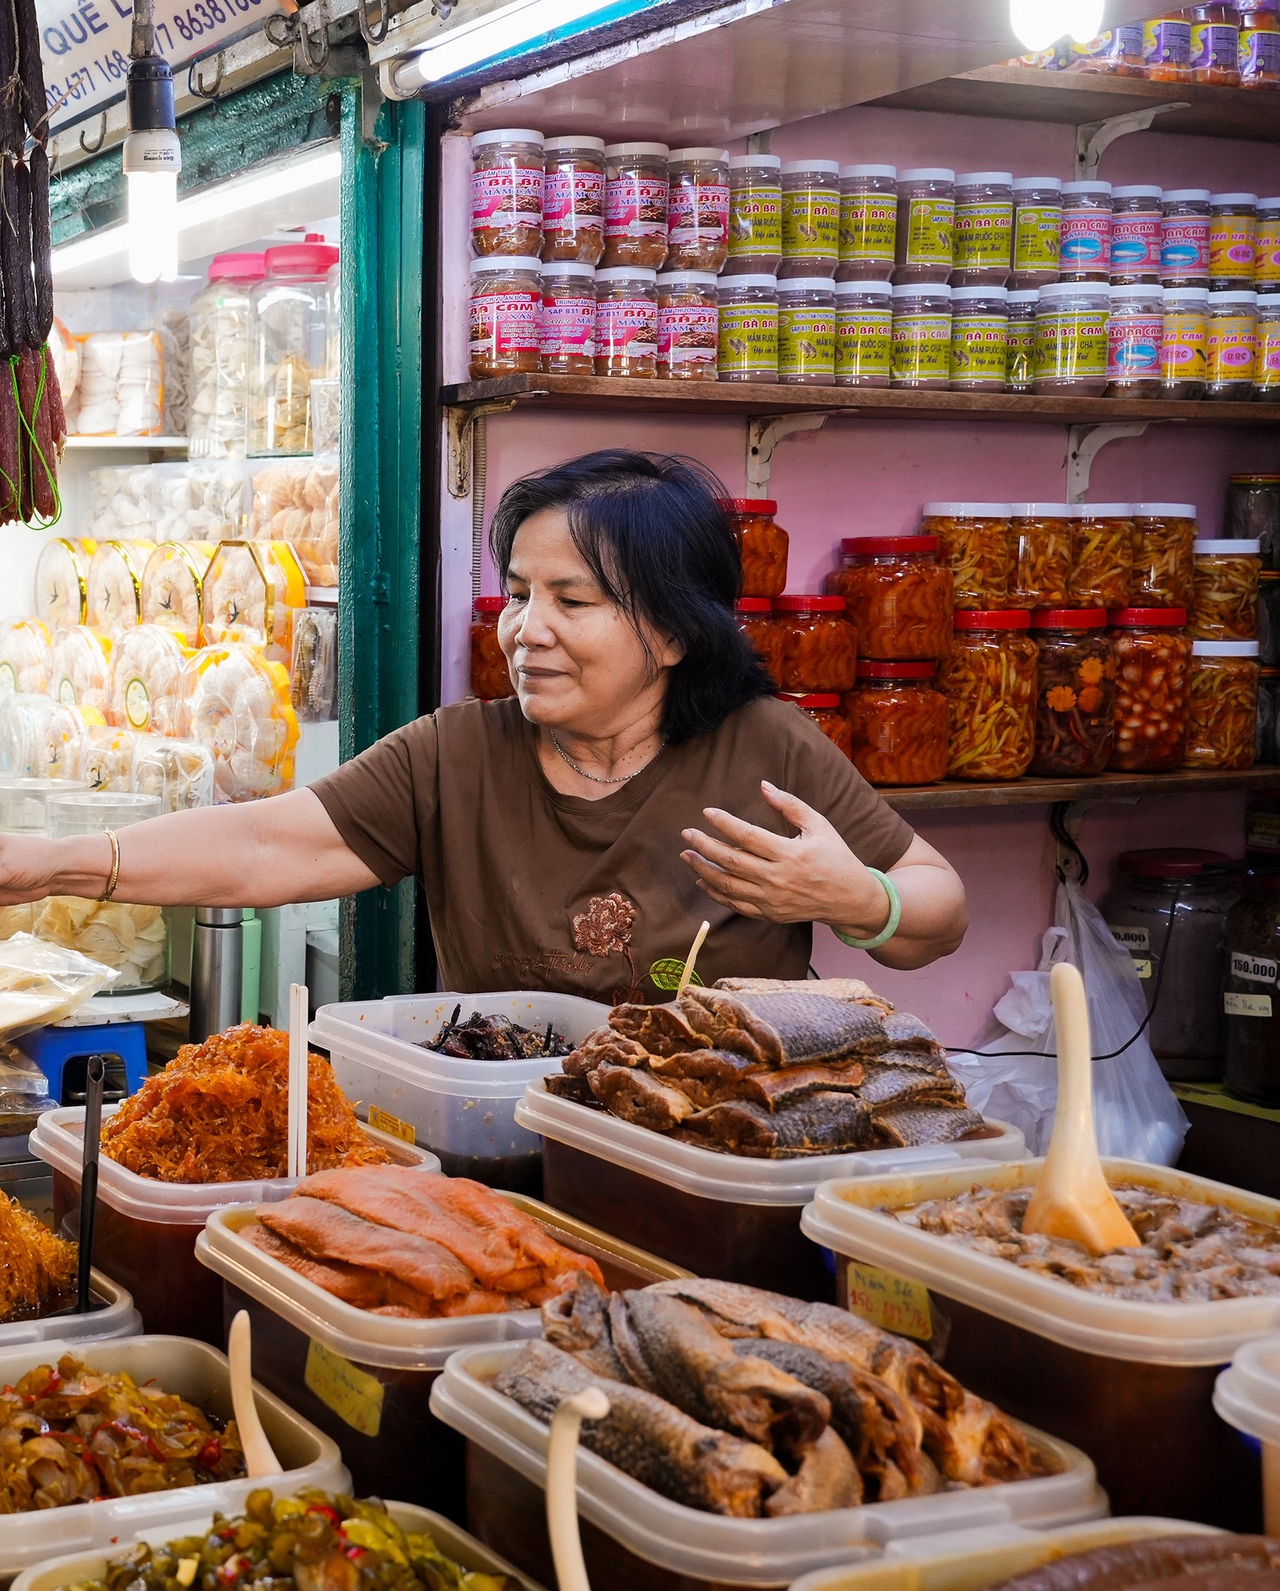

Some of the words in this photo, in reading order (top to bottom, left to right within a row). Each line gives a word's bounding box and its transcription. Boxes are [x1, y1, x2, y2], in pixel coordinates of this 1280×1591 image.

[94, 49, 128, 83] 168
[521, 179, 540, 187] BA
[699, 194, 721, 203] BA
[871, 209, 886, 219] BA
[956, 218, 972, 230] BÀ
[975, 218, 992, 228] BA
[1071, 221, 1088, 231] BA
[1089, 220, 1109, 231] CAM
[1114, 224, 1131, 235] BA
[1132, 223, 1155, 234] CAM
[1167, 228, 1184, 239] BA
[1185, 227, 1206, 238] CAM
[496, 303, 534, 312] CAM
[624, 307, 647, 318] BÀ
[666, 313, 690, 324] BÀ
[697, 315, 716, 324] BA
[742, 318, 759, 330] BÀ
[762, 320, 774, 329] BA
[813, 322, 828, 333] BÀ
[840, 324, 857, 336] BÀ
[860, 326, 876, 335] BA
[1042, 326, 1056, 338] BÀ
[1061, 327, 1076, 336] BA
[1080, 326, 1103, 335] CAM
[892, 330, 908, 341] BÀ
[930, 329, 949, 339] CAM
[966, 330, 983, 341] BÀ
[985, 332, 1000, 341] BA
[1227, 352, 1248, 362] BBC
[1233, 957, 1276, 979] 150.000
